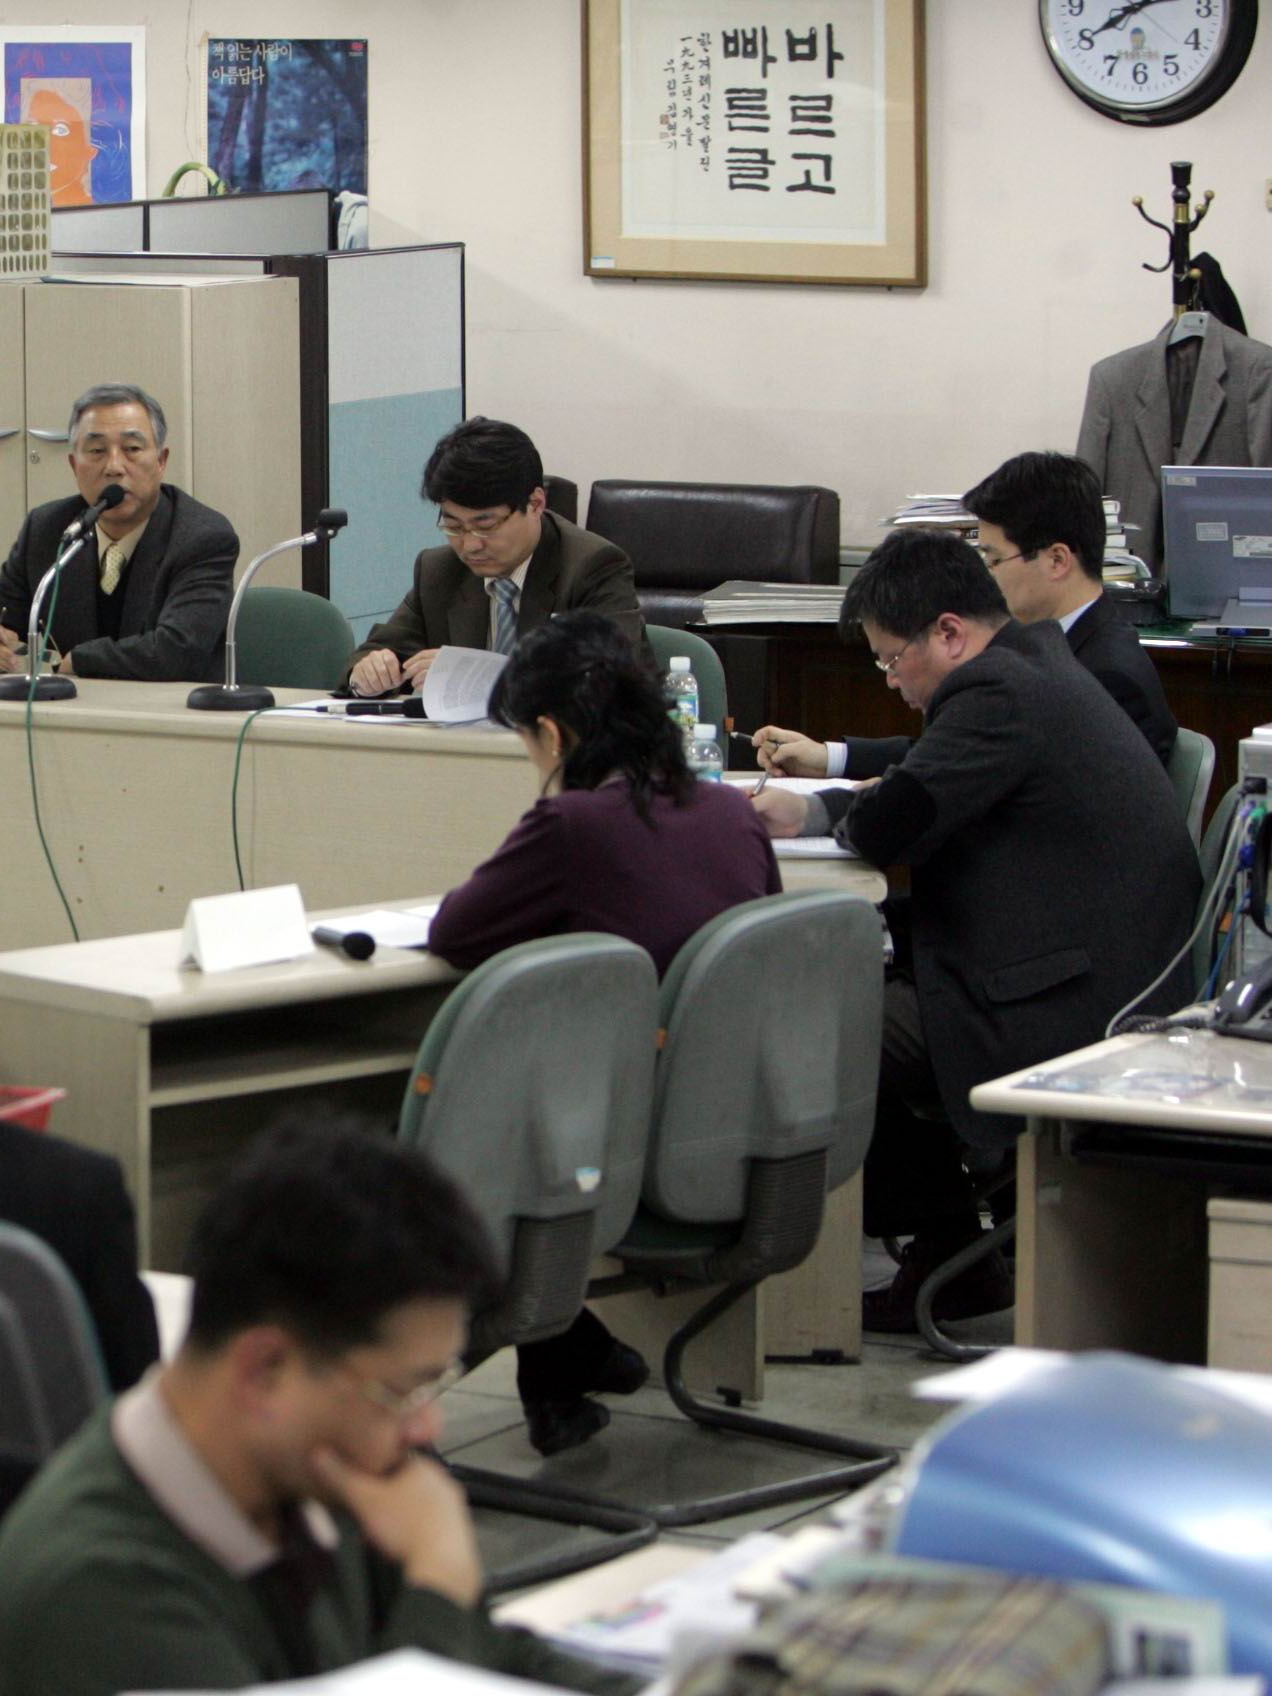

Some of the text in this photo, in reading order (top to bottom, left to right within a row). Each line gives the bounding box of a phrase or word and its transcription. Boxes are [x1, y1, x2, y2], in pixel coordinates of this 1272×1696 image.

[1068, 0, 1084, 17] 9
[1195, 0, 1212, 18] 3
[1077, 28, 1095, 51] 8
[1184, 28, 1201, 50] 4
[213, 42, 292, 62] 책 읽는 사람이
[212, 66, 265, 85] 아름답다
[1103, 55, 1119, 77] 7
[1132, 62, 1148, 85] 6
[1163, 54, 1179, 76] 5
[722, 26, 777, 191] 빠른글
[786, 23, 844, 194] 바르고
